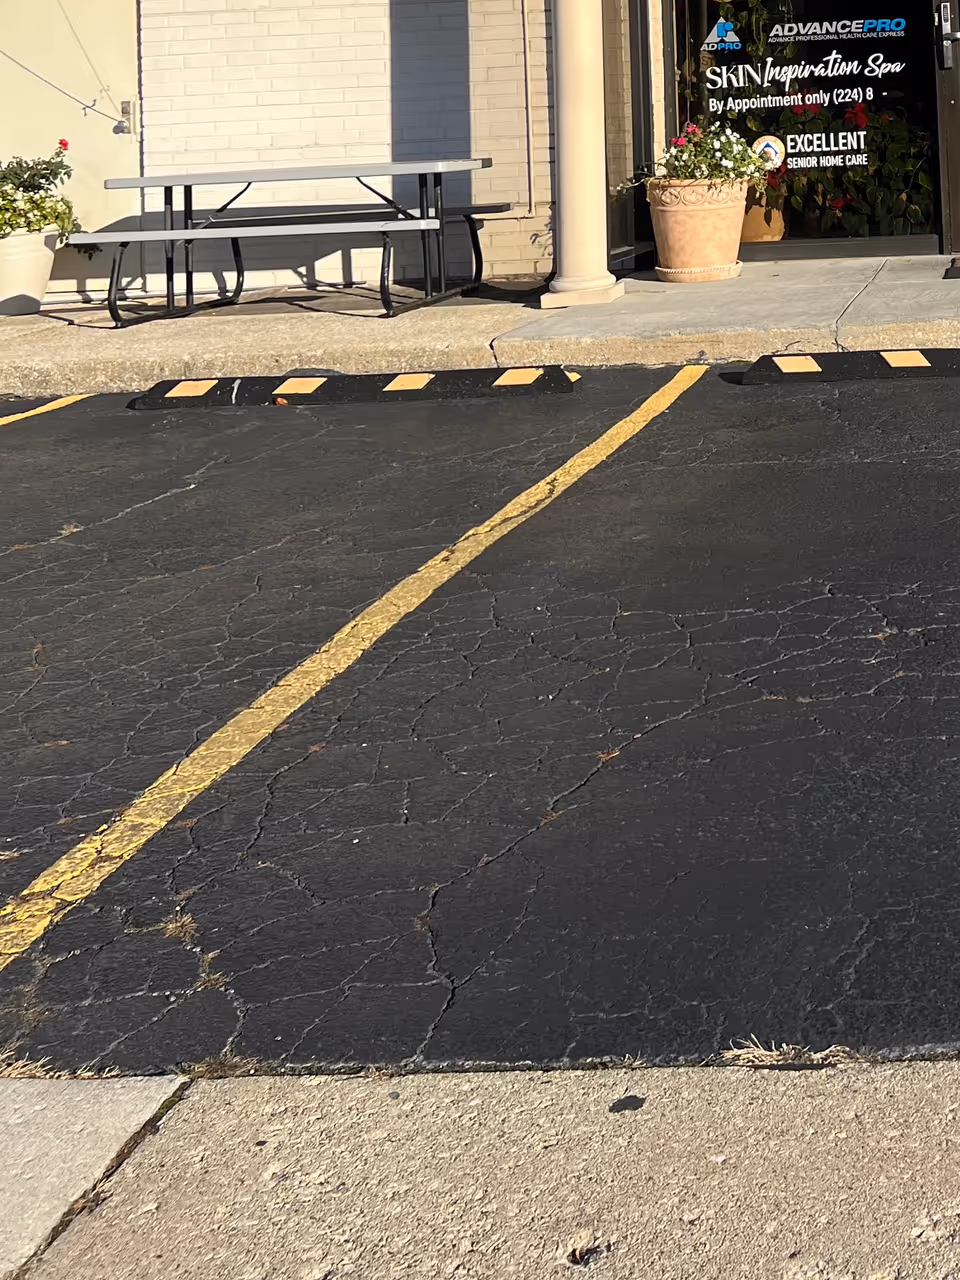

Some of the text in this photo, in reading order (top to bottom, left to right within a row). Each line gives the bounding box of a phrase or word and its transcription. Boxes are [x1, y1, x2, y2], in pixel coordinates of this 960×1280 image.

[768, 30, 905, 43] ADVANCE PROFESSIONAL HEALTH CARE EXPRESS
[769, 18, 907, 37] ADVANCEPRO
[700, 41, 742, 51] ADPRO
[706, 49, 906, 92] SKIN Inspiration Spa
[709, 98, 725, 114] By
[727, 94, 803, 112] Appointment
[804, 90, 831, 107] only
[833, 87, 863, 104] (224)
[786, 131, 867, 153] EXCELLENT
[786, 153, 868, 169] SENIOR HOME CARE
